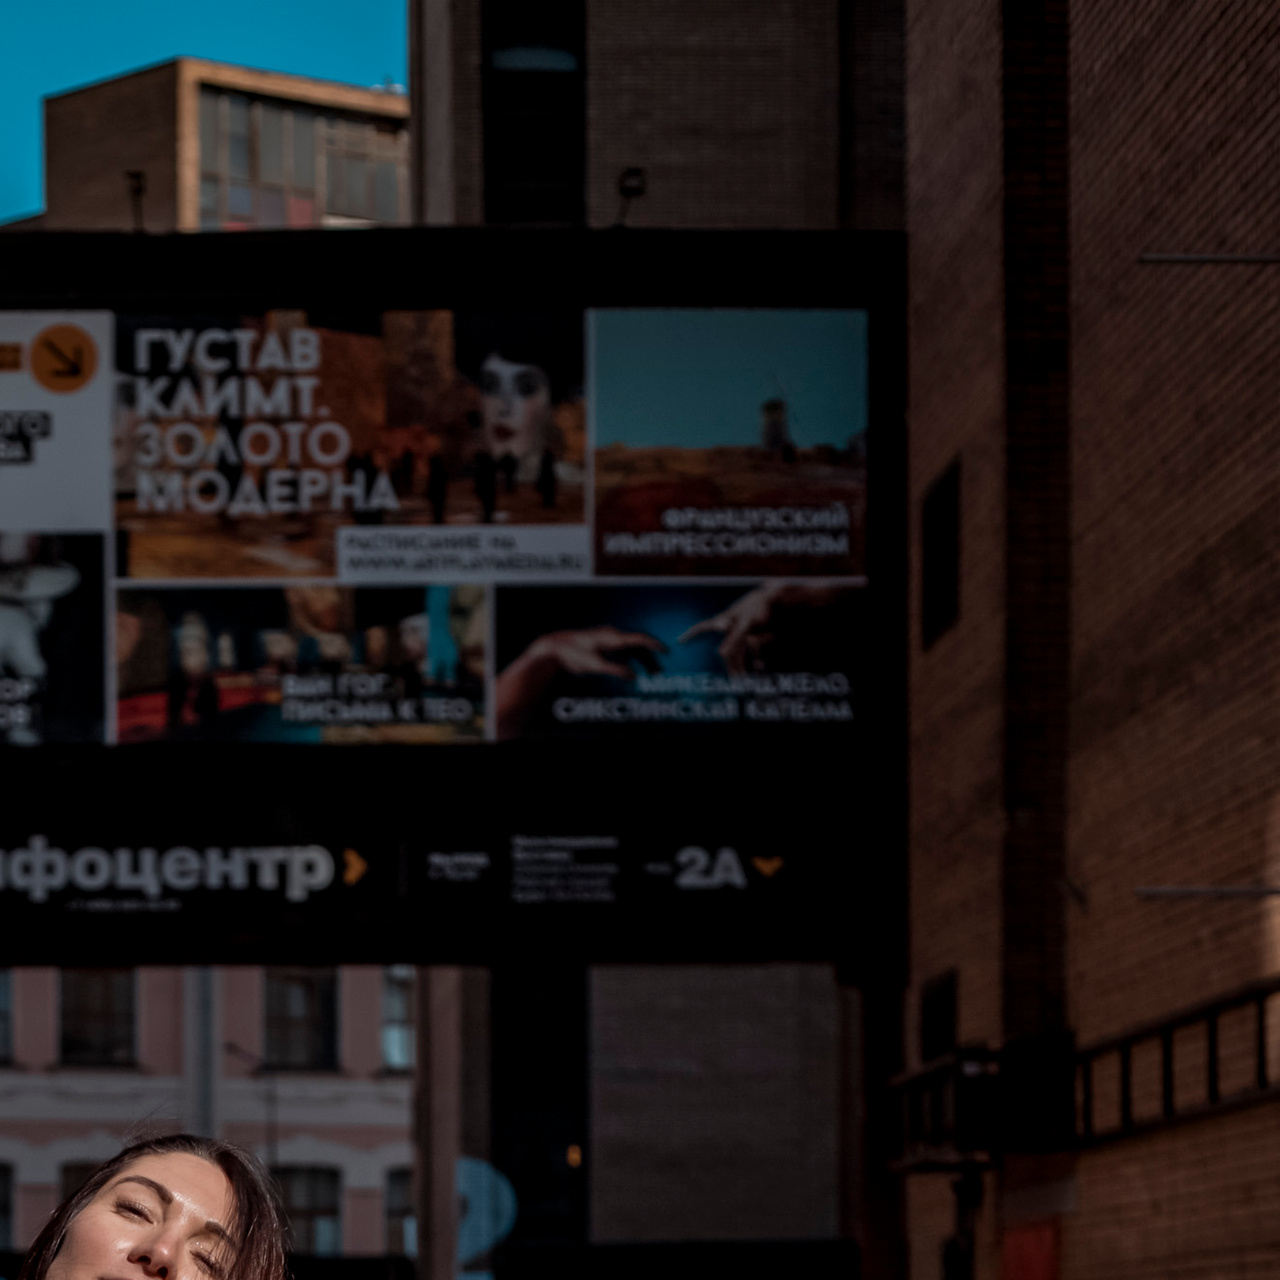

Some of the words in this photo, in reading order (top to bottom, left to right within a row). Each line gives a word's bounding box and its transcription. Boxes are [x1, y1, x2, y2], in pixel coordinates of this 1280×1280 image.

[134, 327, 322, 373] ГУСТАВ
[135, 376, 331, 418] КЛИМТ.
[135, 422, 353, 466] ЗОЛОТО
[136, 468, 402, 517] МОДЕРНА
